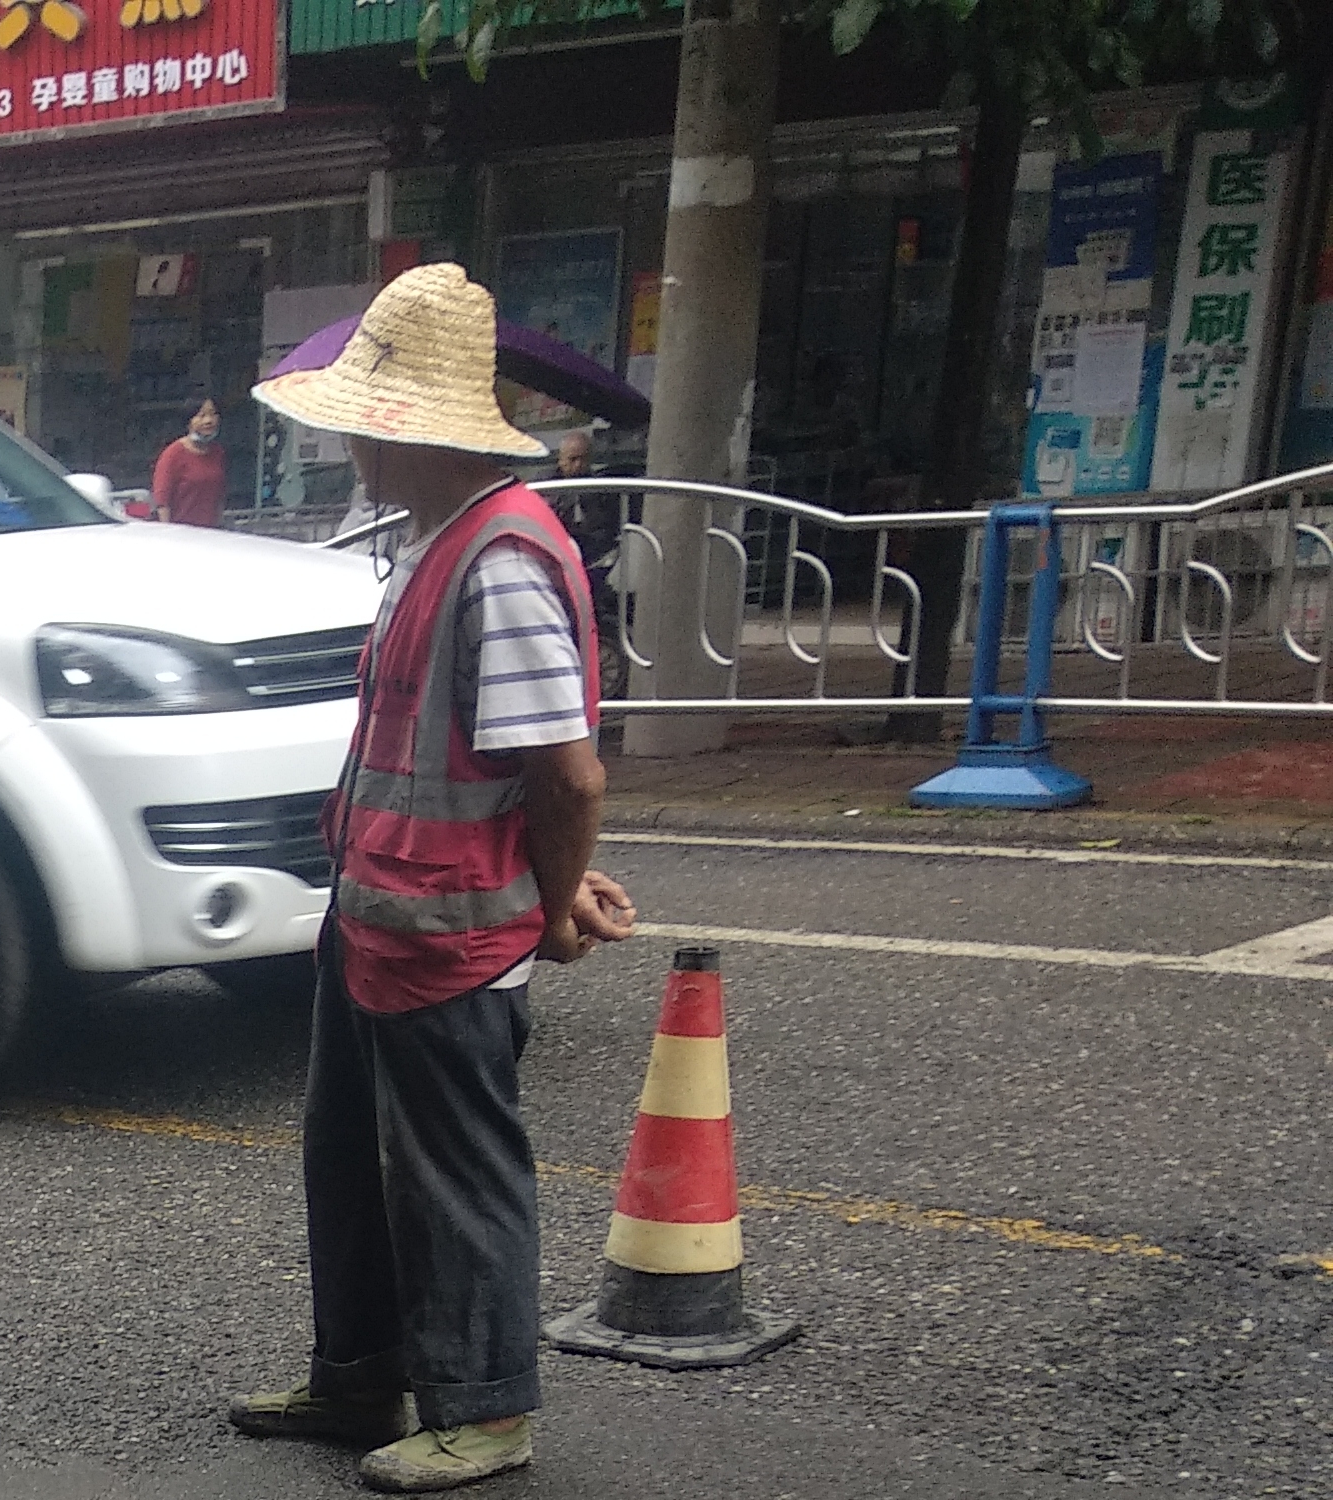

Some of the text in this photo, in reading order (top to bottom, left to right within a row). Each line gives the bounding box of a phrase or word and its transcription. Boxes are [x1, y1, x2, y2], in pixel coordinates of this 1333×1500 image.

[31, 47, 249, 112] 孕婴童购物中心
